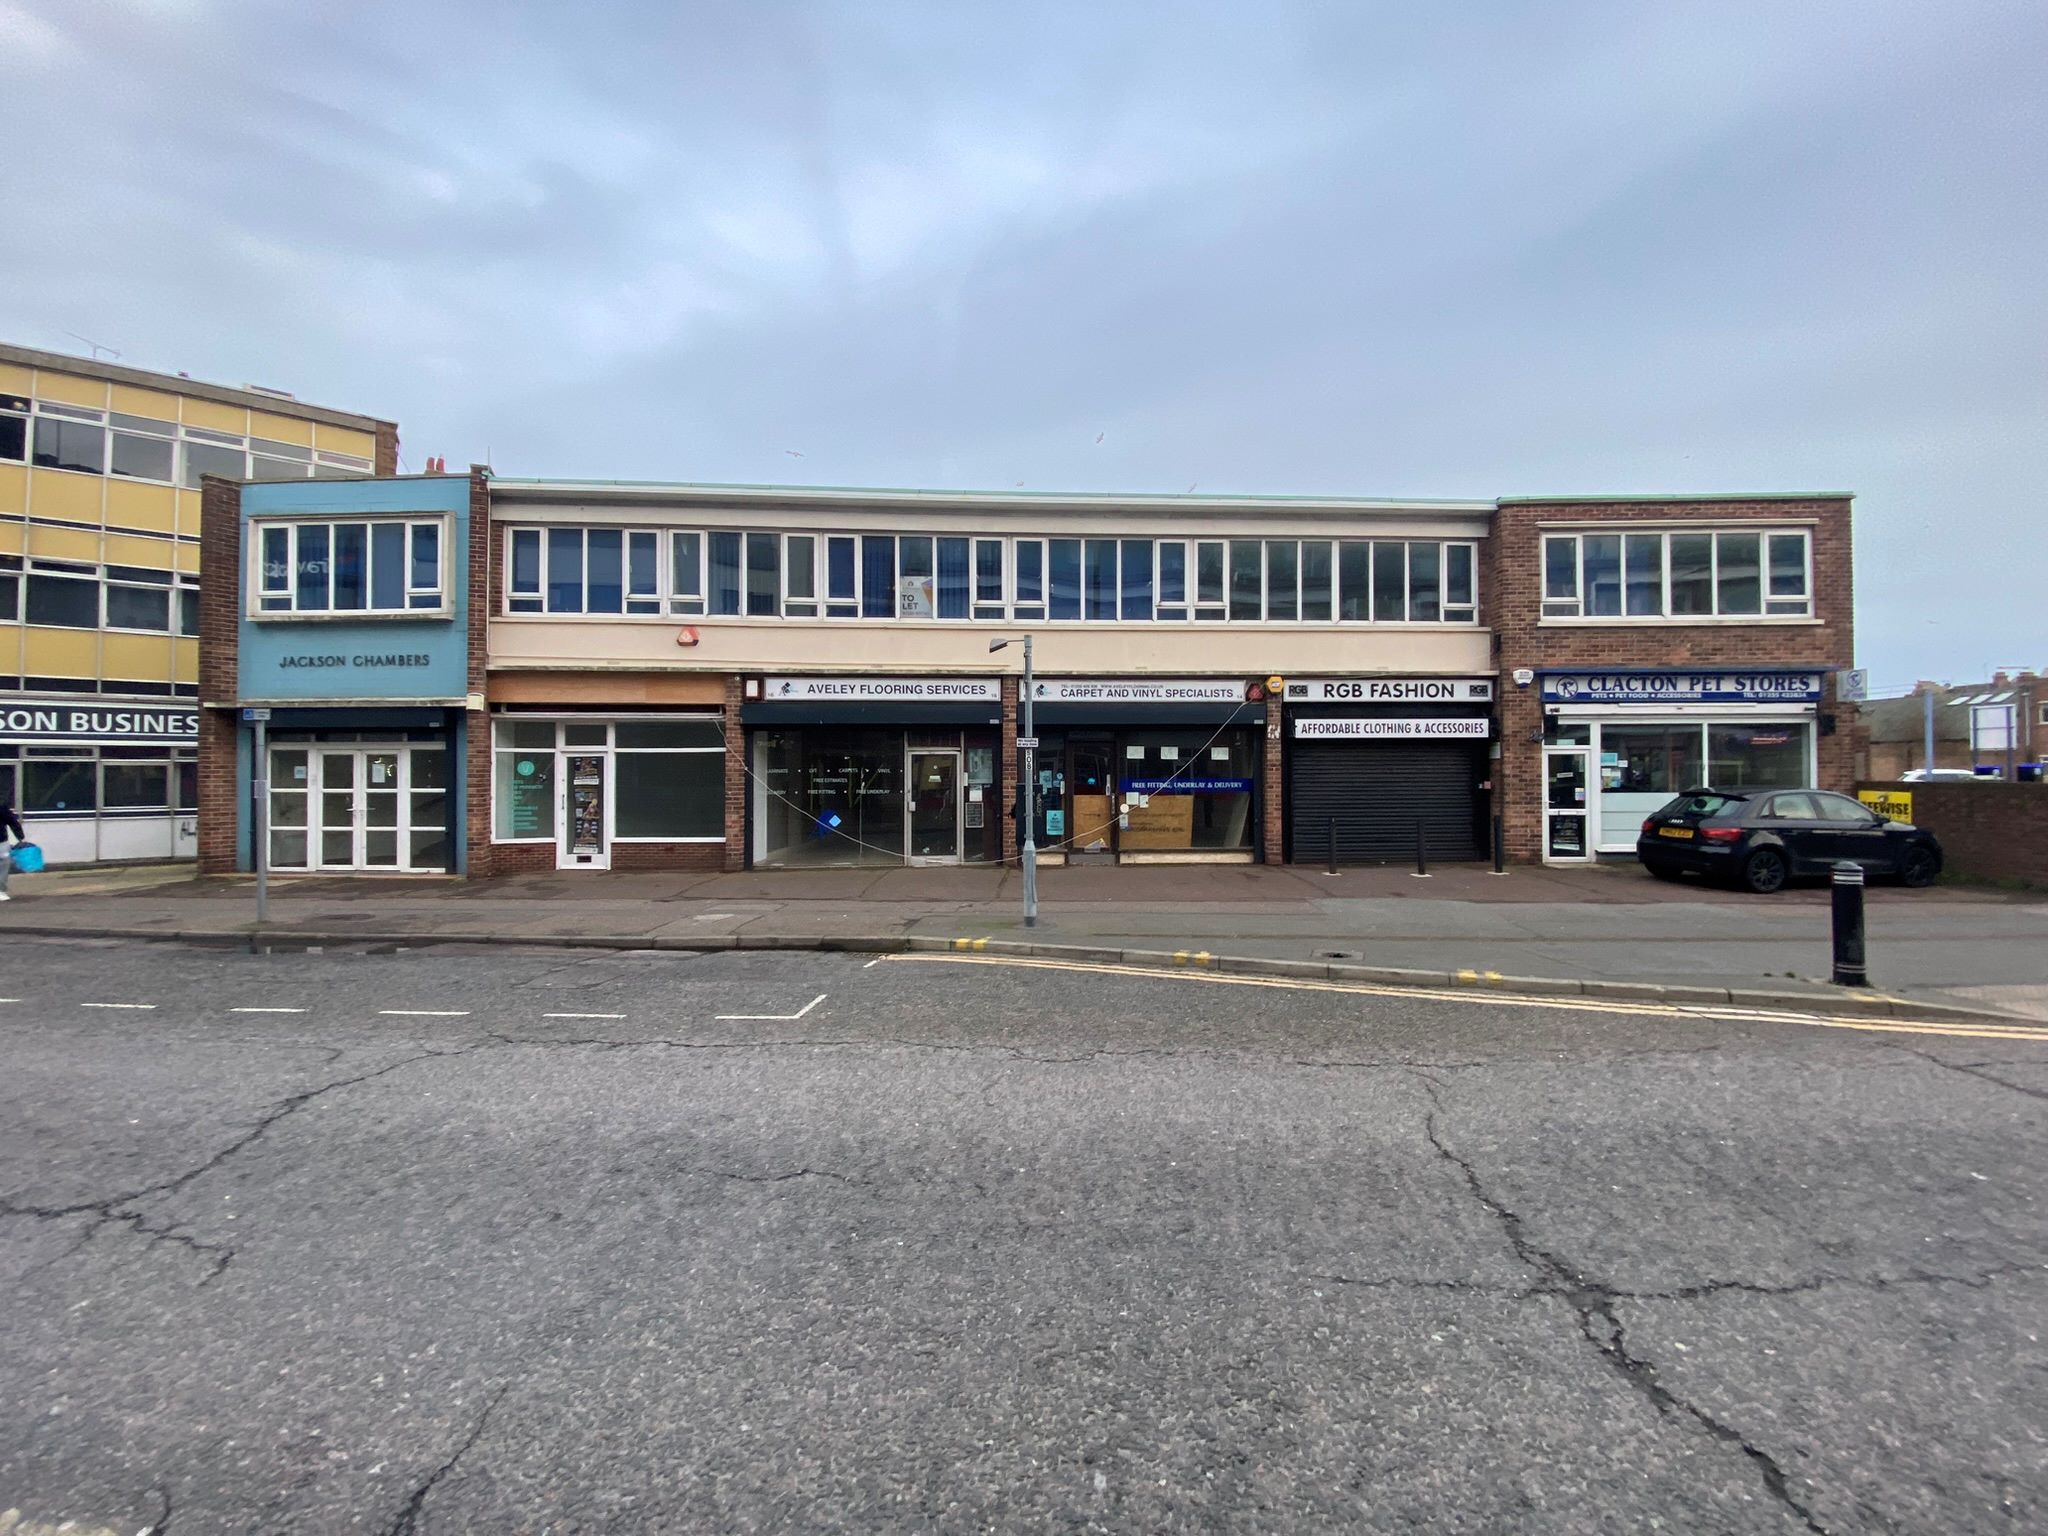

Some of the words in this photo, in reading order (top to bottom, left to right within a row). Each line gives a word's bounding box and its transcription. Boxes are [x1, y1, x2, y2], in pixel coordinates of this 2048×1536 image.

[902, 602, 918, 610] LET
[279, 656, 346, 668] JACKSON
[353, 655, 430, 667] CHAMBERS
[1587, 676, 1678, 692] CLACTON
[1689, 676, 1725, 691] PET
[1734, 675, 1810, 691] STORES
[807, 684, 856, 695] AVELEY
[859, 684, 923, 695] FLOORING
[926, 684, 987, 695] SERVICES
[1060, 688, 1103, 698] CARPET
[1106, 688, 1129, 698] AND
[1132, 688, 1162, 698] VINYL
[1165, 688, 1234, 698] SPECIALISTS
[1289, 685, 1308, 694] RGB
[1323, 683, 1363, 698] RGB
[1370, 683, 1455, 698] FASHION
[1469, 685, 1489, 694] RGB
[1301, 722, 1360, 735] AFFORDABLE
[1364, 722, 1412, 734] CLOTHING
[1414, 722, 1422, 734] &
[1424, 722, 1484, 734] ACCESSORIES
